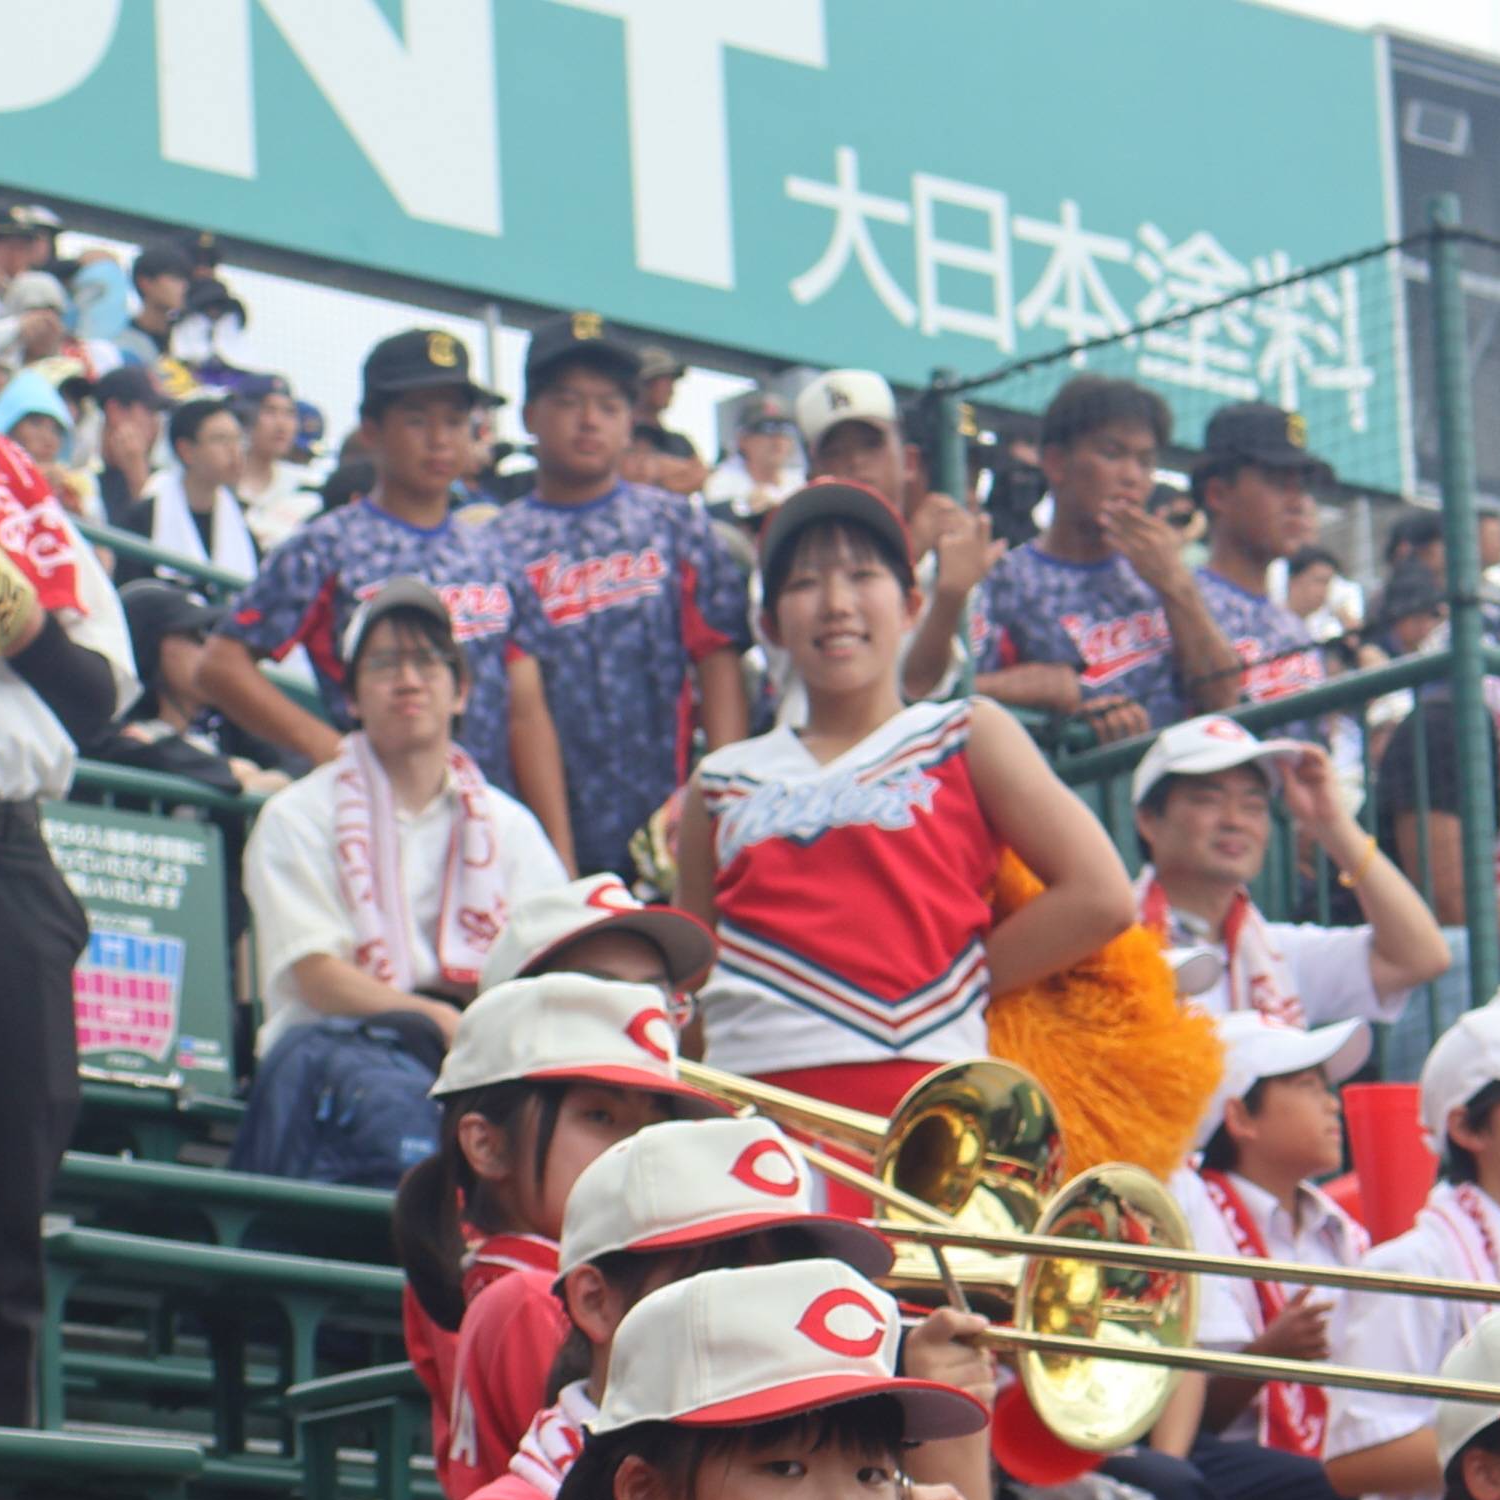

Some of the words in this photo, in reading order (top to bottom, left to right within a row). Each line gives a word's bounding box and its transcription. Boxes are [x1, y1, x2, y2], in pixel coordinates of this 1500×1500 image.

[784, 146, 1373, 432] 大日本塗料
[730, 1140, 802, 1197] C
[797, 1288, 888, 1358] C
